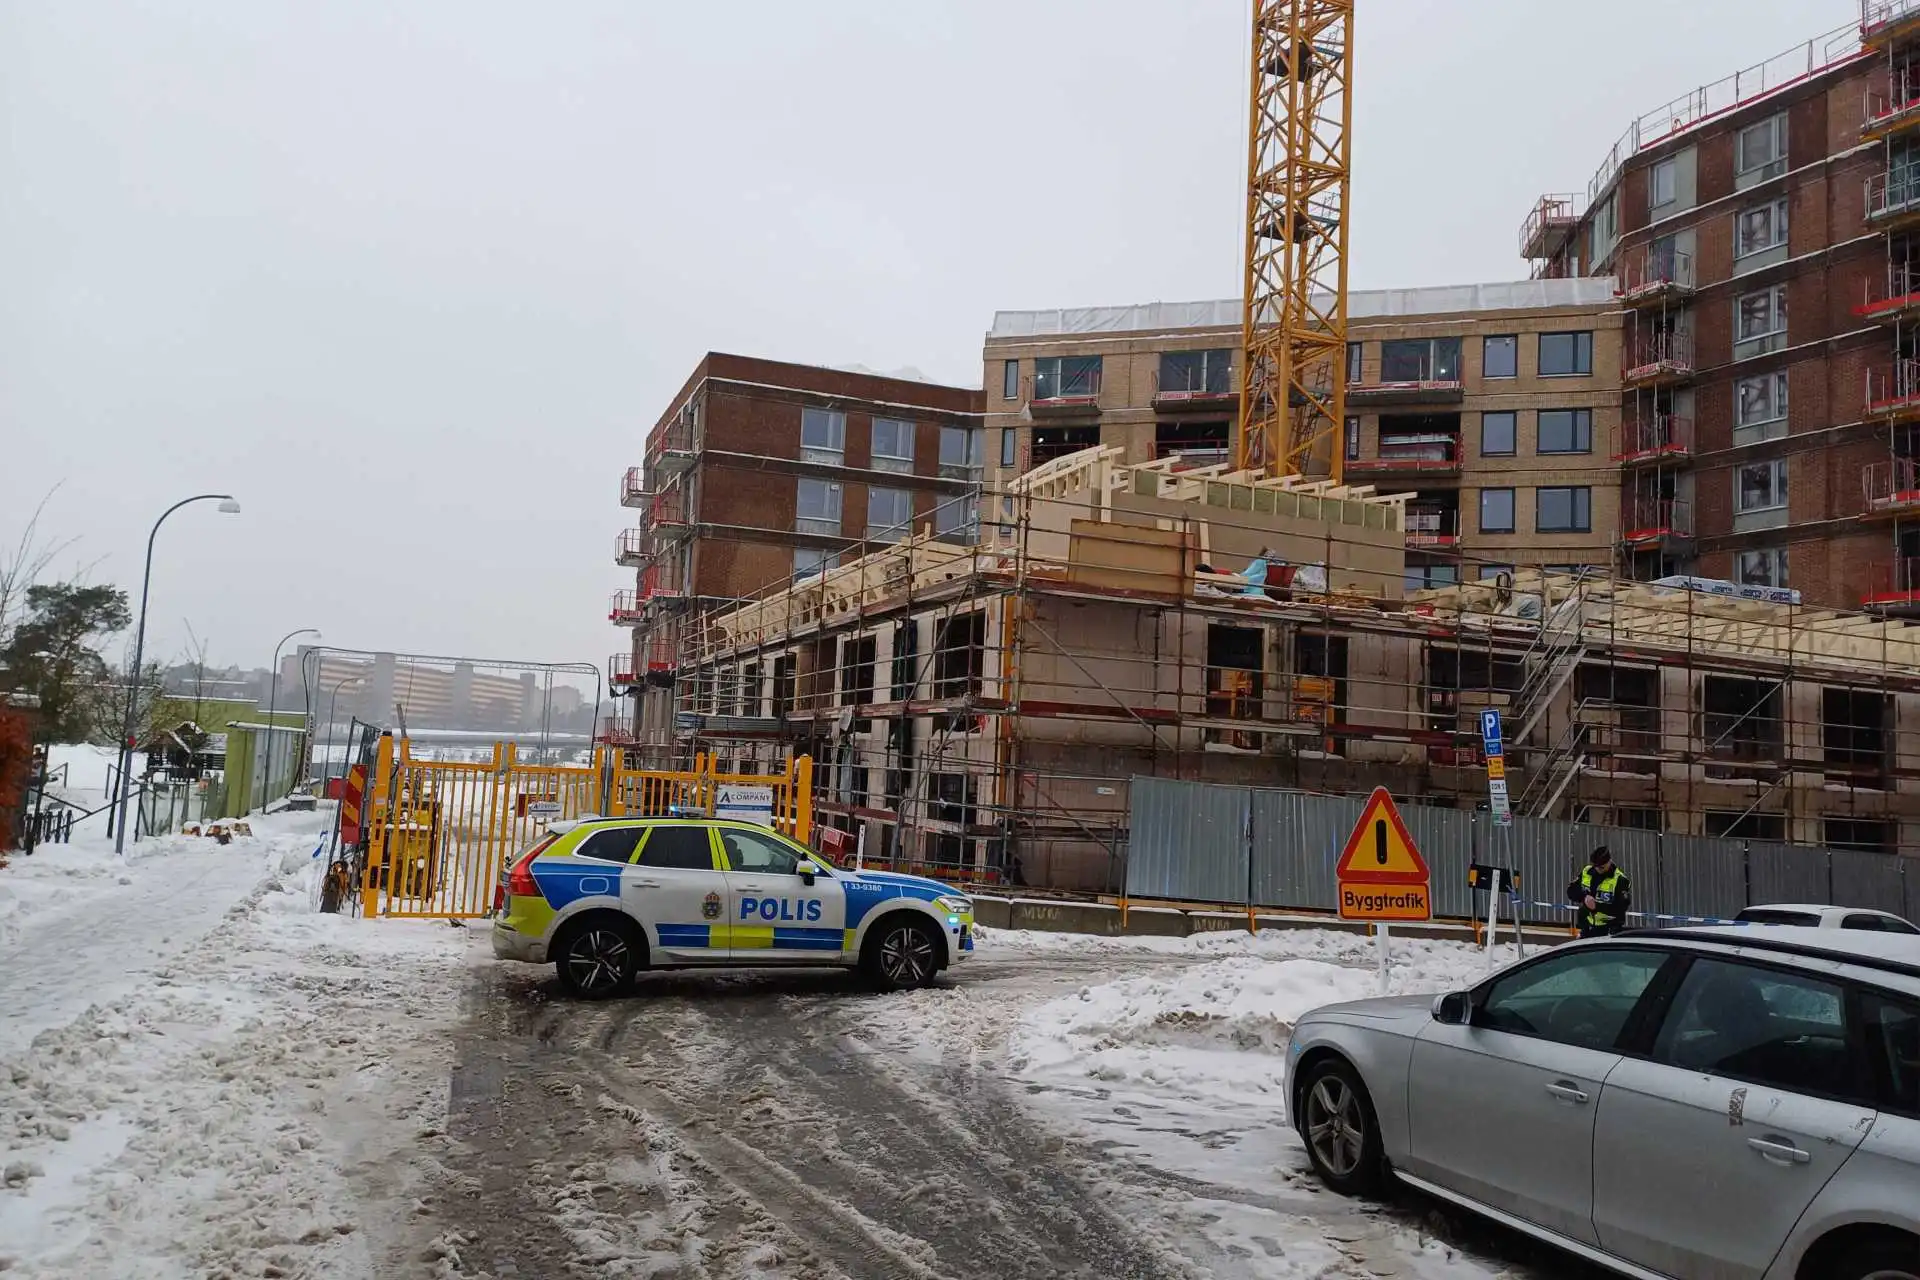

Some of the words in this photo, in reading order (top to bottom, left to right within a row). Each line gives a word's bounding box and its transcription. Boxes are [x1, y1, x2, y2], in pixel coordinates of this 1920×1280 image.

[1485, 714, 1496, 738] P
[740, 897, 822, 922] POLIS
[1344, 890, 1425, 911] Byggtrafik
